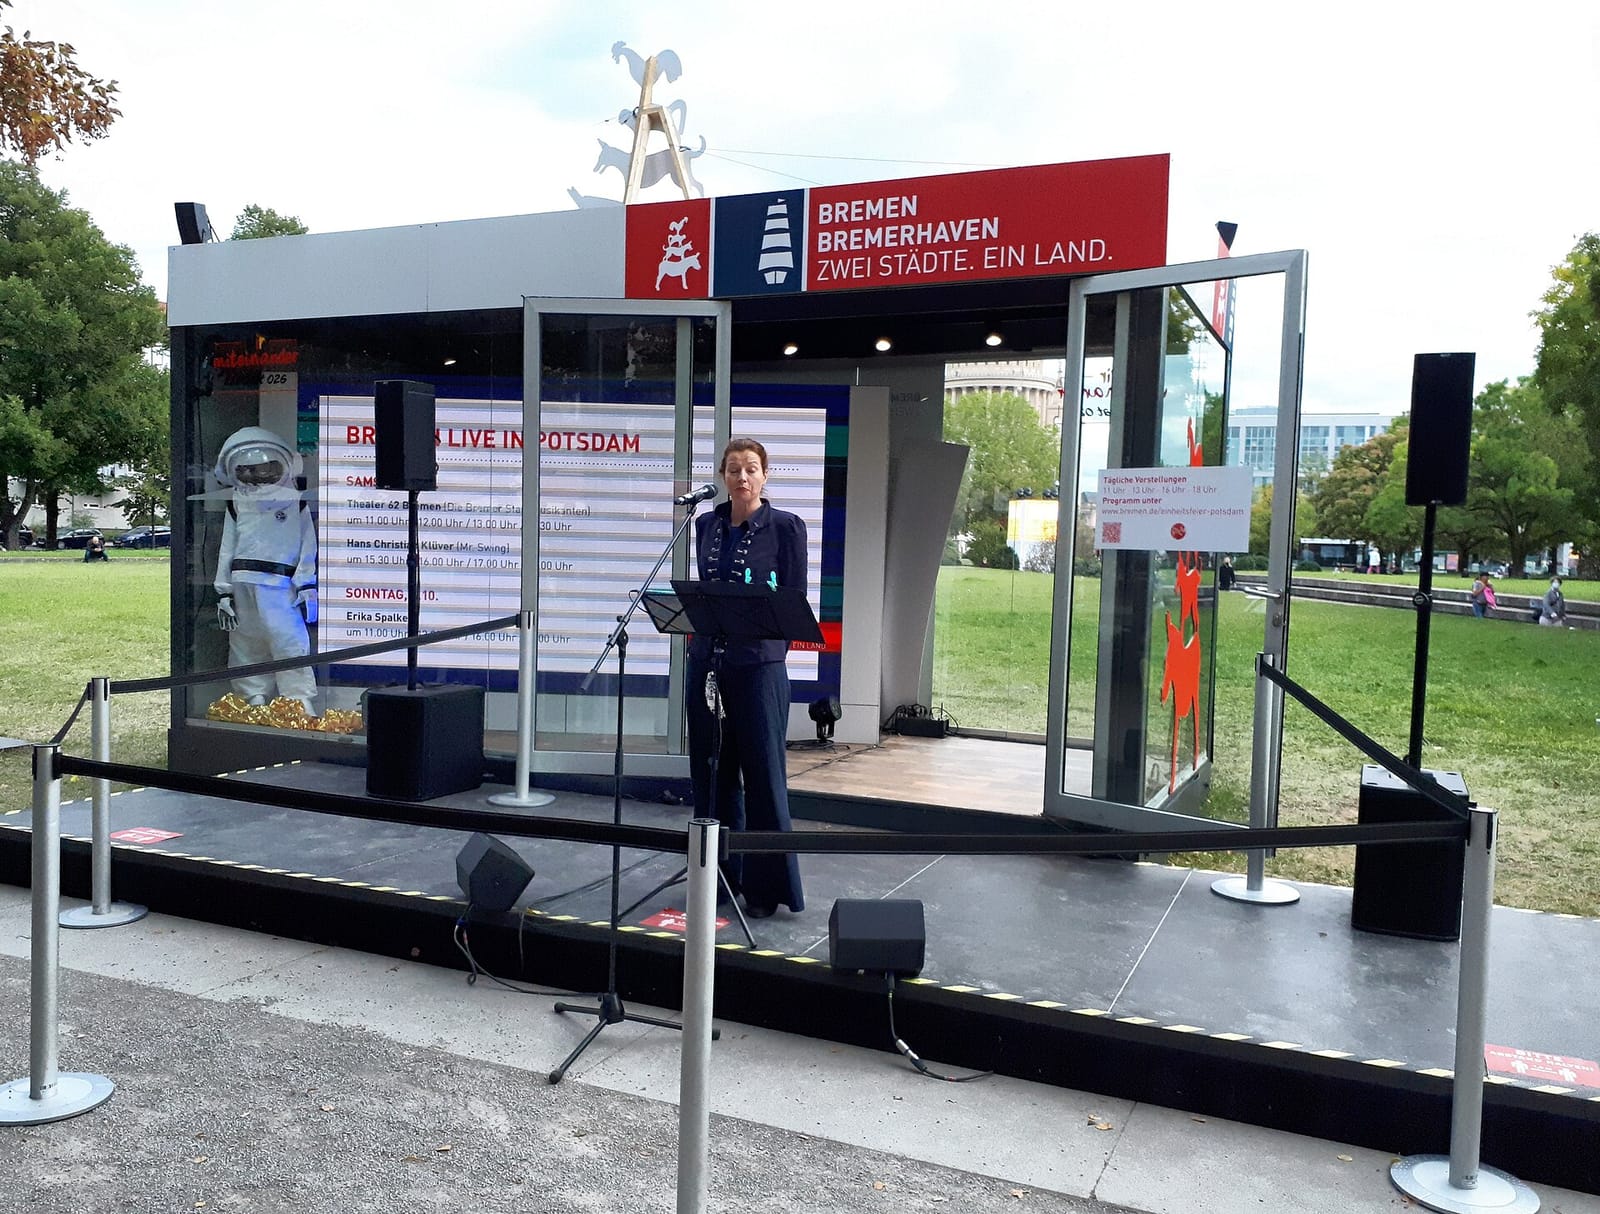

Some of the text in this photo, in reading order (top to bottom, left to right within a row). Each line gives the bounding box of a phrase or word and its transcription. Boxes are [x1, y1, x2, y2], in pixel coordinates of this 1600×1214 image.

[818, 195, 918, 225] BREMEN
[817, 216, 1000, 253] BREMERHAVEN
[816, 238, 1113, 281] ZWEI STÄDTE. EIN LAND.
[449, 428, 496, 449] LIVE
[503, 430, 523, 449] IN
[539, 431, 640, 453] POTSDAM
[1134, 475, 1187, 486] Vorstellungen
[1141, 486, 1155, 494] Uhr
[1171, 486, 1186, 494] Uhr
[1202, 485, 1217, 494] Uhr
[388, 500, 400, 510] 62
[403, 501, 442, 512] Bmen
[1102, 497, 1162, 506] Programm unter
[346, 516, 362, 525] um
[365, 515, 389, 526] 11.00
[419, 518, 443, 528] 12.00
[445, 518, 463, 528] Uhr
[473, 519, 497, 529] 13.00
[499, 519, 518, 530] Uhr
[553, 521, 572, 532] Uhr
[346, 538, 372, 549] Hans
[421, 541, 454, 551] Klüver
[346, 556, 362, 564] um
[365, 555, 389, 565] 15.30
[420, 557, 443, 567] 16.00
[446, 558, 464, 567] Uhr
[474, 559, 498, 569] 17.00
[500, 559, 518, 569] Uhr
[555, 561, 573, 571] Uhr
[345, 587, 407, 602] SONNTAG,
[346, 612, 408, 624] Erika Spalke
[346, 629, 361, 637] um
[364, 628, 388, 638] 11.00
[498, 632, 517, 642] Uhr
[552, 634, 570, 644] Uhr
[792, 641, 805, 649] EIN
